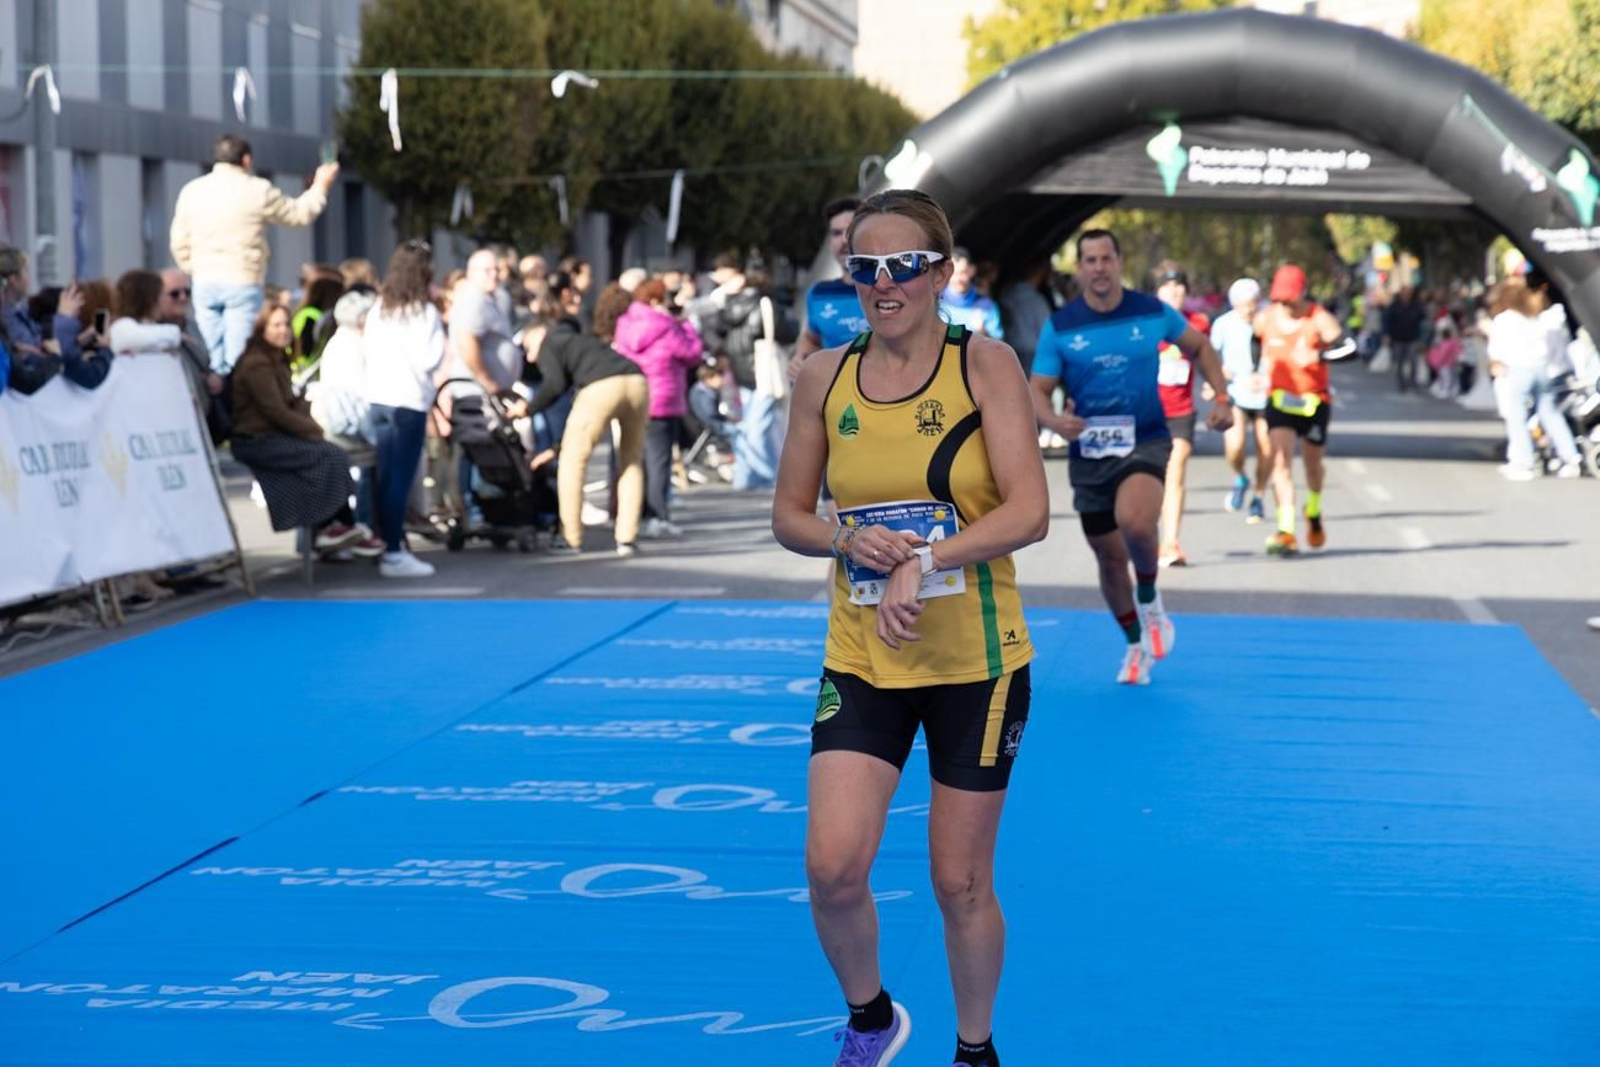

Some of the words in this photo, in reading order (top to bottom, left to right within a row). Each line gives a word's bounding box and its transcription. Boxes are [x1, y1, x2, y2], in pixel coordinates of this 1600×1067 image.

[280, 877, 498, 887] MEDIA
[232, 971, 440, 985] JAÉN
[87, 998, 354, 1011] MEDIA
